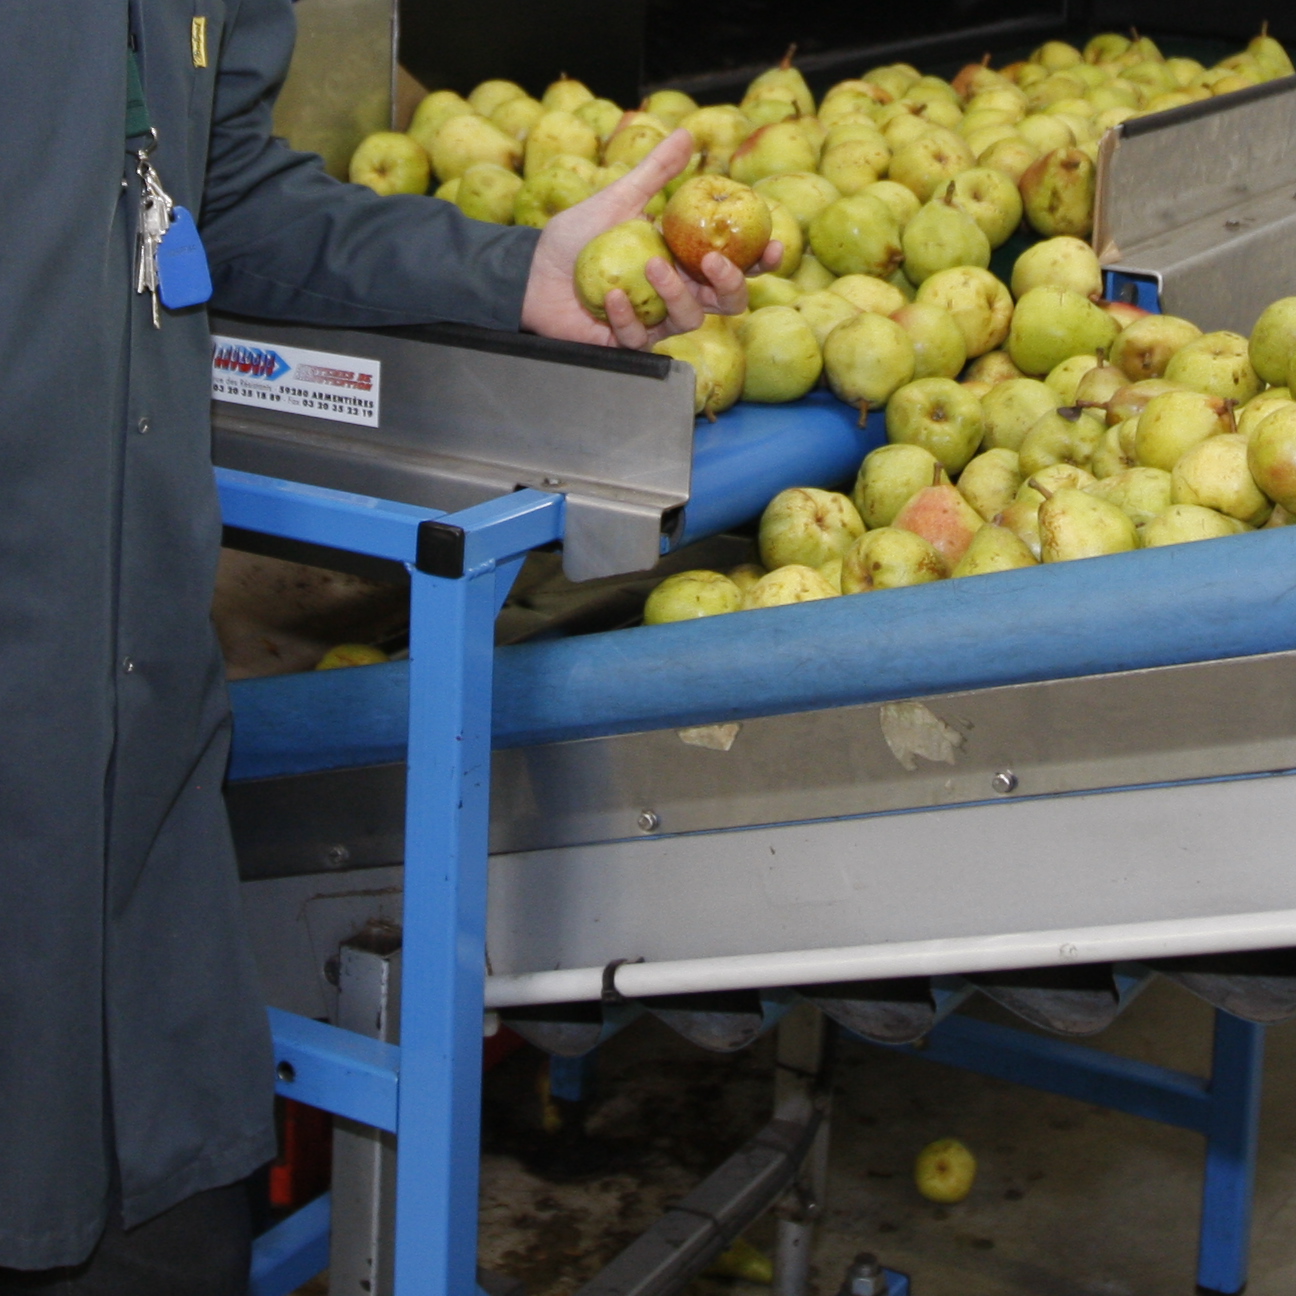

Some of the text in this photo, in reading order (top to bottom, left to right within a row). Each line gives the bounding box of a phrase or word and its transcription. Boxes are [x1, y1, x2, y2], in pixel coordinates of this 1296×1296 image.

[227, 385, 238, 394] 20
[302, 398, 313, 408] 03
[317, 401, 328, 410] 20
[332, 403, 343, 413] 35
[362, 408, 372, 418] 19
[279, 385, 308, 397] 59280
[311, 389, 373, 408] ARMENTIÈRES
